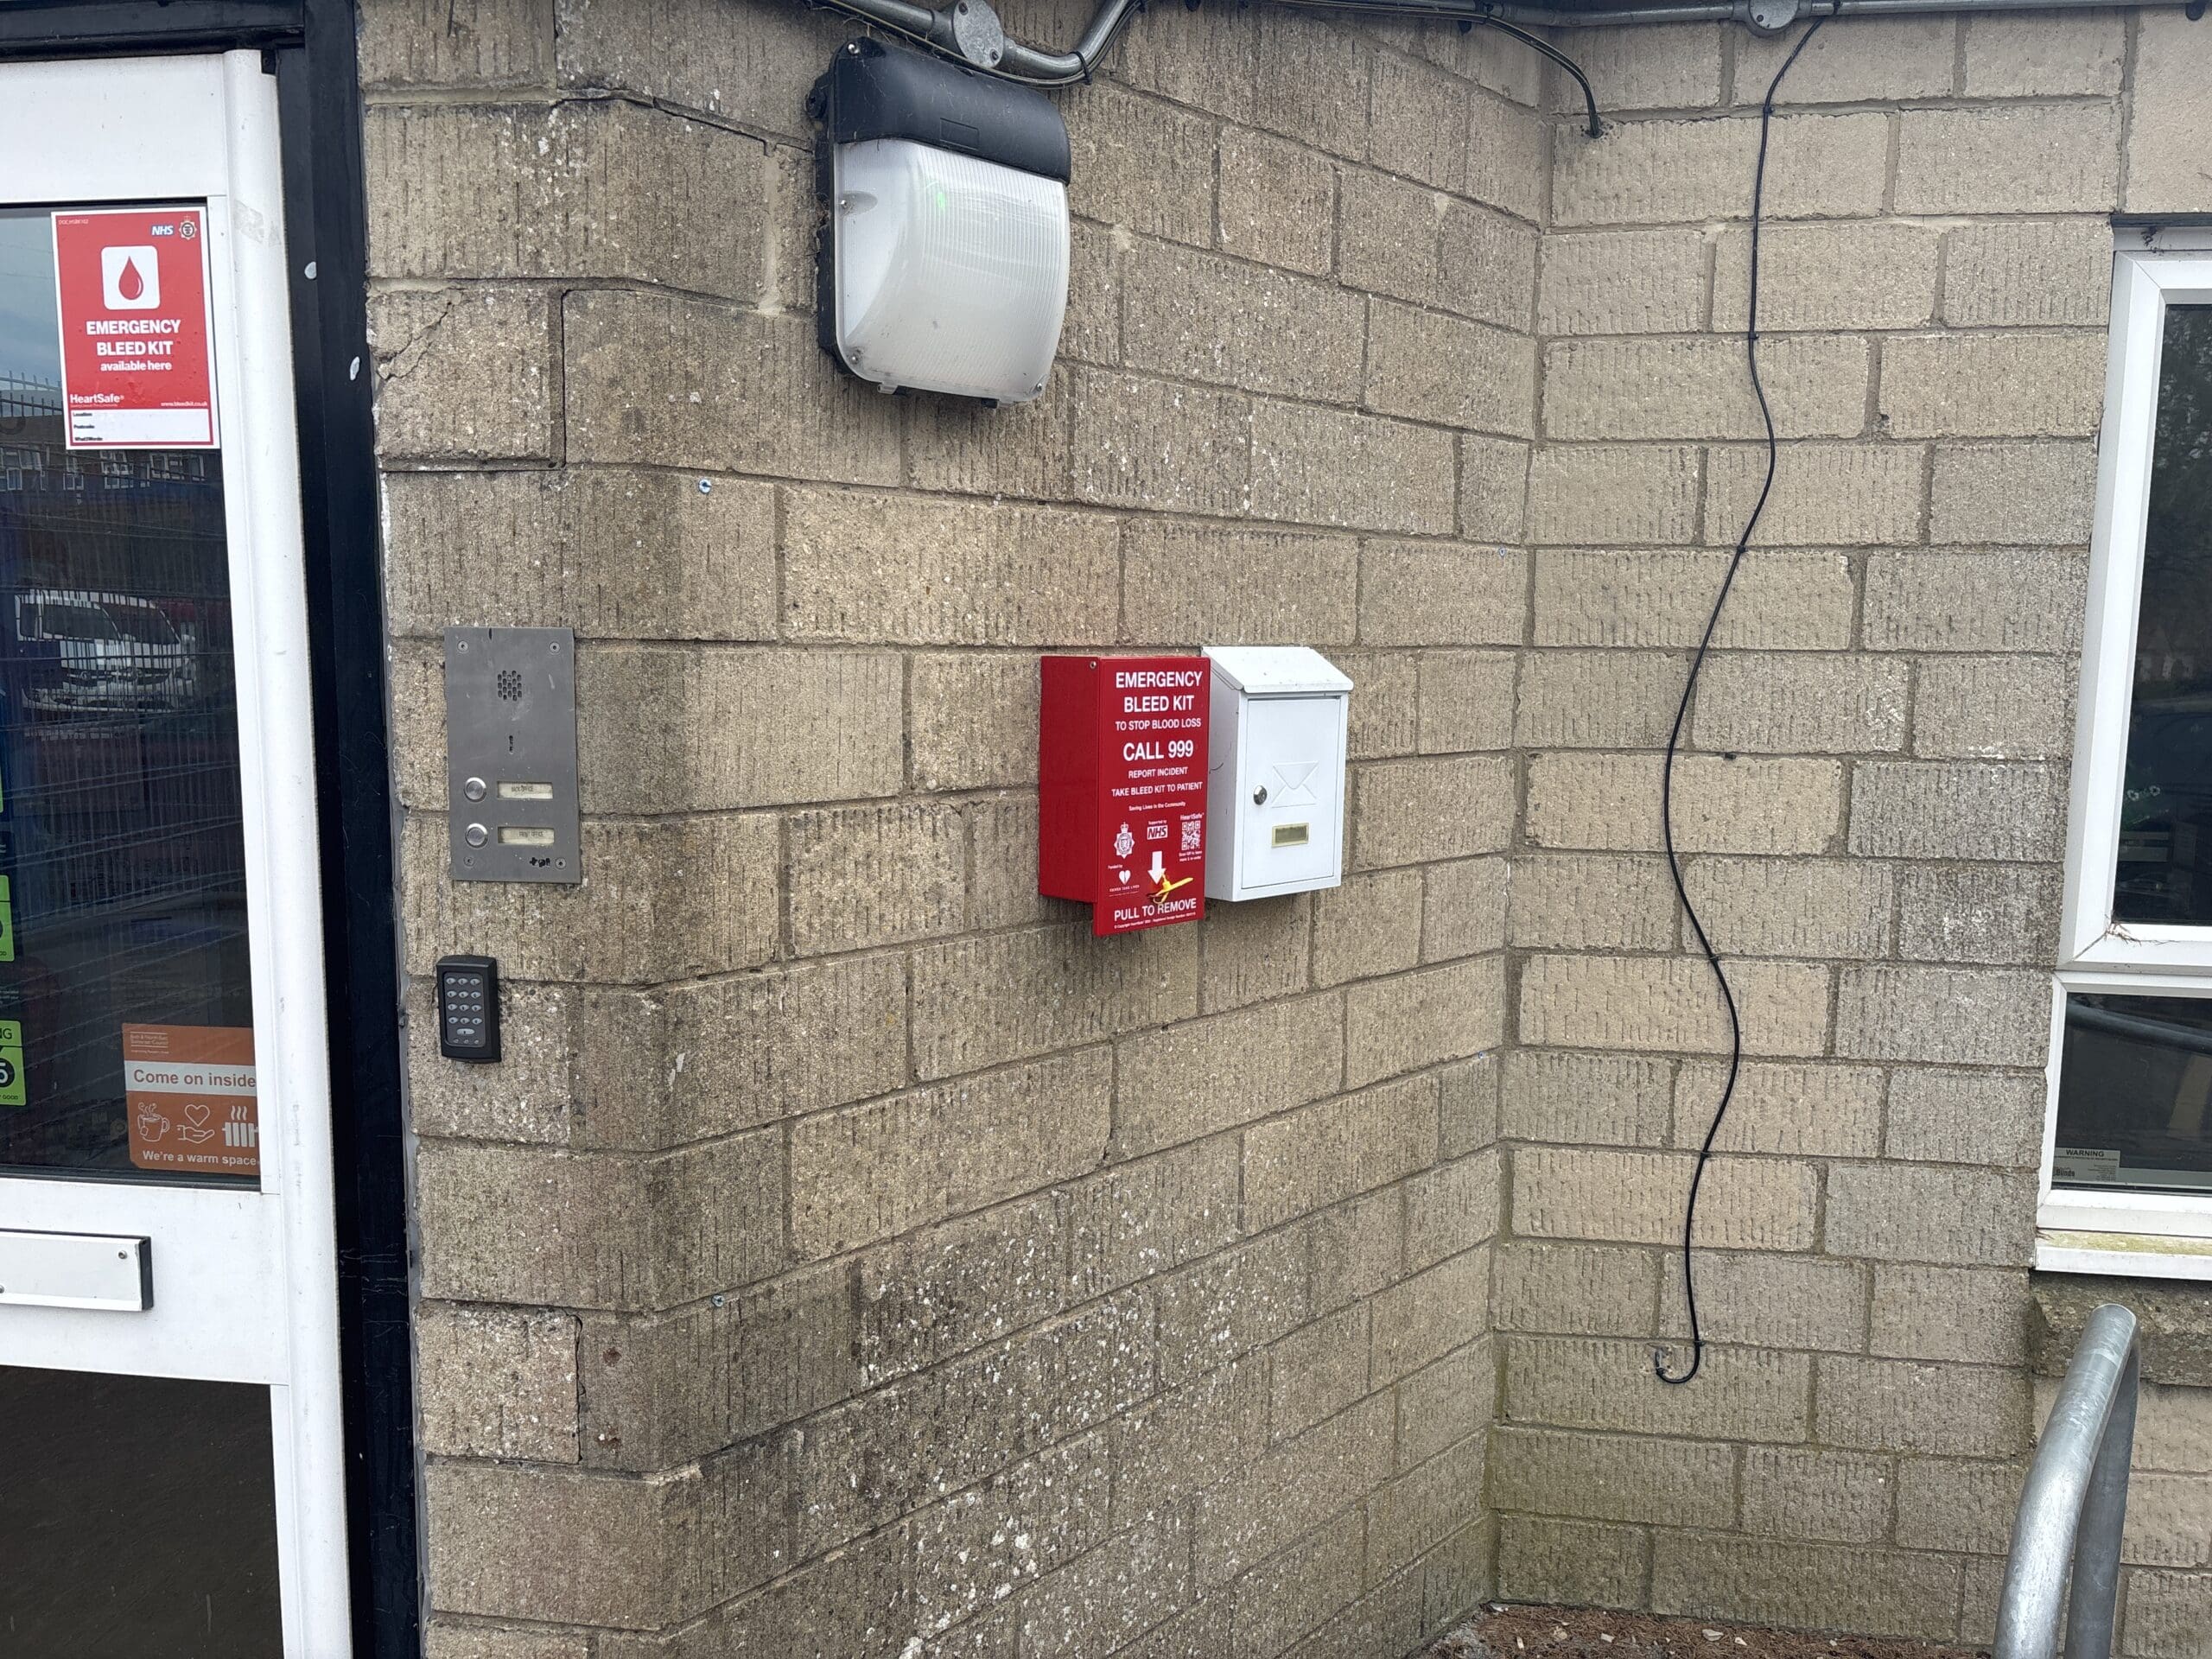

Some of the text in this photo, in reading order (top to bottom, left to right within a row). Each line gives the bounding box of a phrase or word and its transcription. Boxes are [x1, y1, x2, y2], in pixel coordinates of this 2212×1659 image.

[151, 226, 173, 236] NHS
[86, 320, 181, 335] EMERGENCY
[97, 341, 174, 356] BLEED KIT
[100, 360, 172, 372] available here
[1116, 671, 1203, 689] EMERGENCY
[1124, 695, 1195, 713] BLEED KIT
[1116, 718, 1202, 731] TO STOP BLOOD LOSS
[1123, 740, 1193, 761] CALL 999
[1128, 766, 1188, 779] REPORT INCIDENT
[1111, 781, 1203, 797] TAKE BLEED KIT TO PATIENT
[1147, 827, 1166, 838] NHS
[1115, 898, 1197, 921] PULL TO REMOVE
[134, 1069, 256, 1087] Come on inside
[143, 1150, 174, 1161] We're
[187, 1154, 219, 1164] warm
